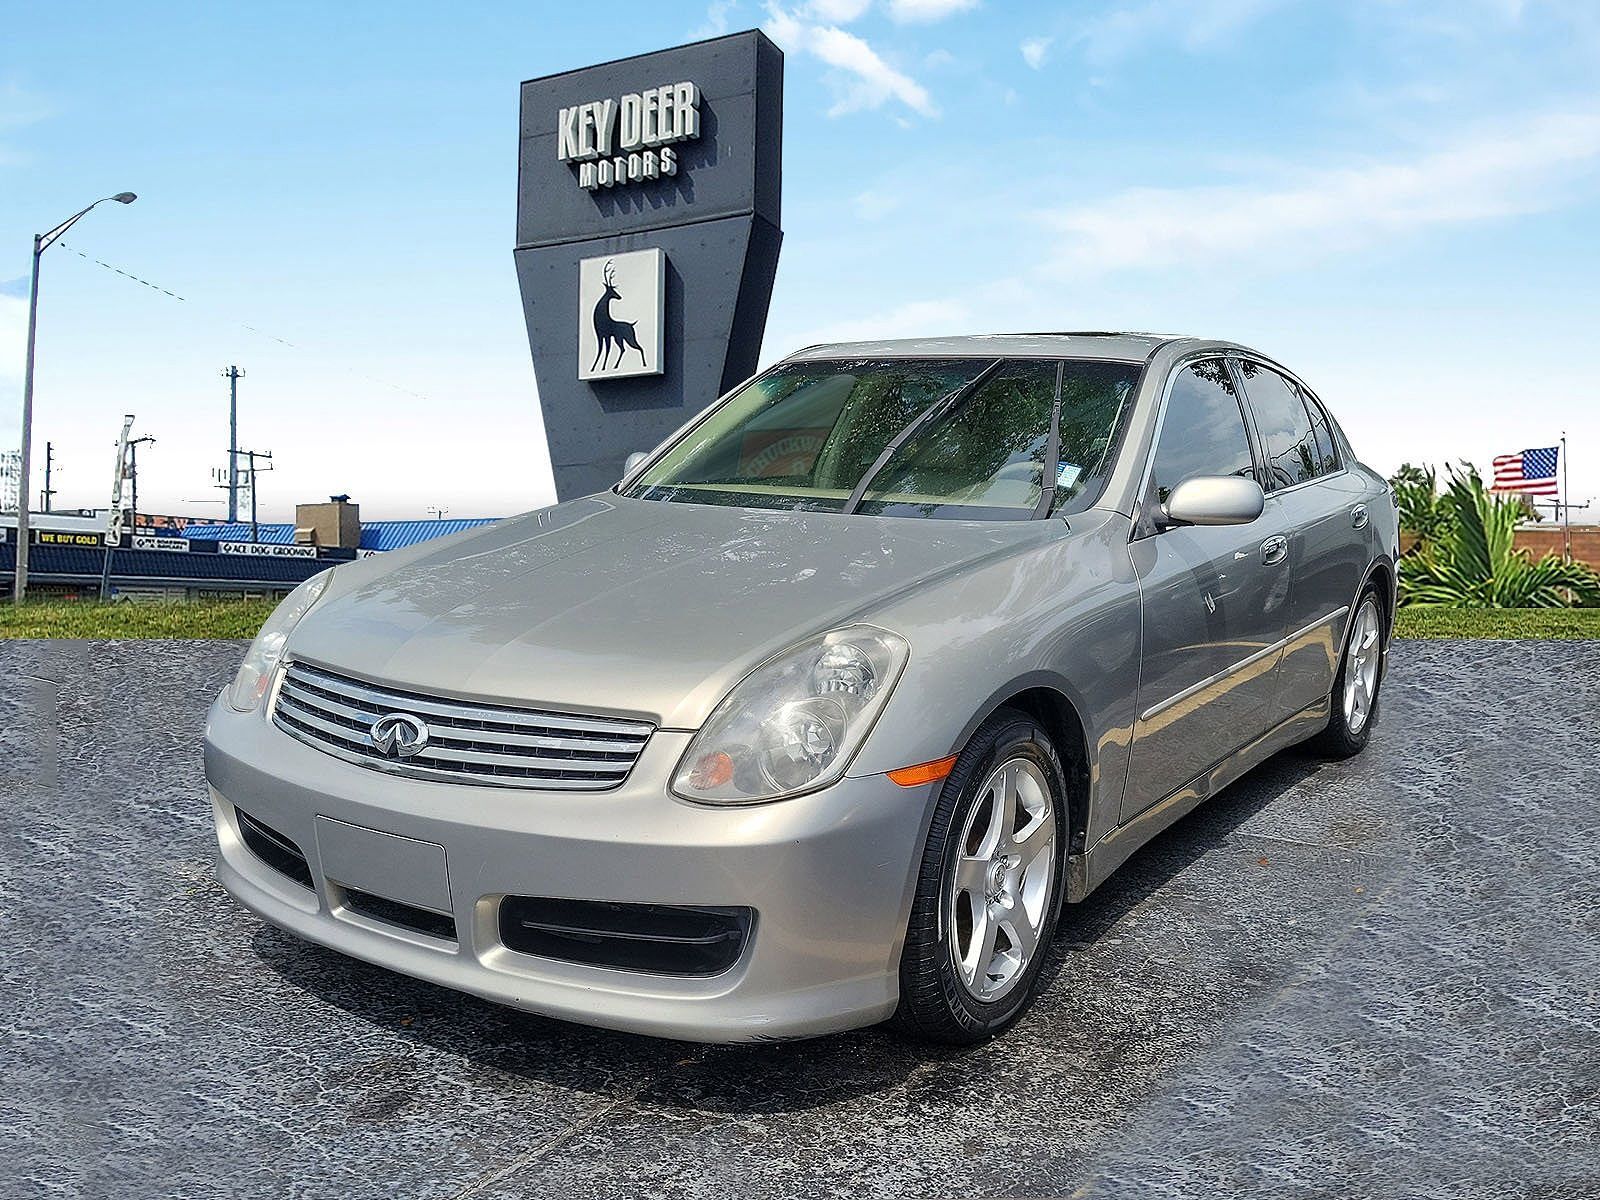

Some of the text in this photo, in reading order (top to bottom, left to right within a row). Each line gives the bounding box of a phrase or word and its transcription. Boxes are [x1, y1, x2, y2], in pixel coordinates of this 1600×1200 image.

[557, 81, 699, 161] KEY DEER
[579, 147, 677, 191] MOTORS
[41, 533, 98, 545] WE BUY GOLD
[232, 544, 315, 557] ACE DOG GROOMING
